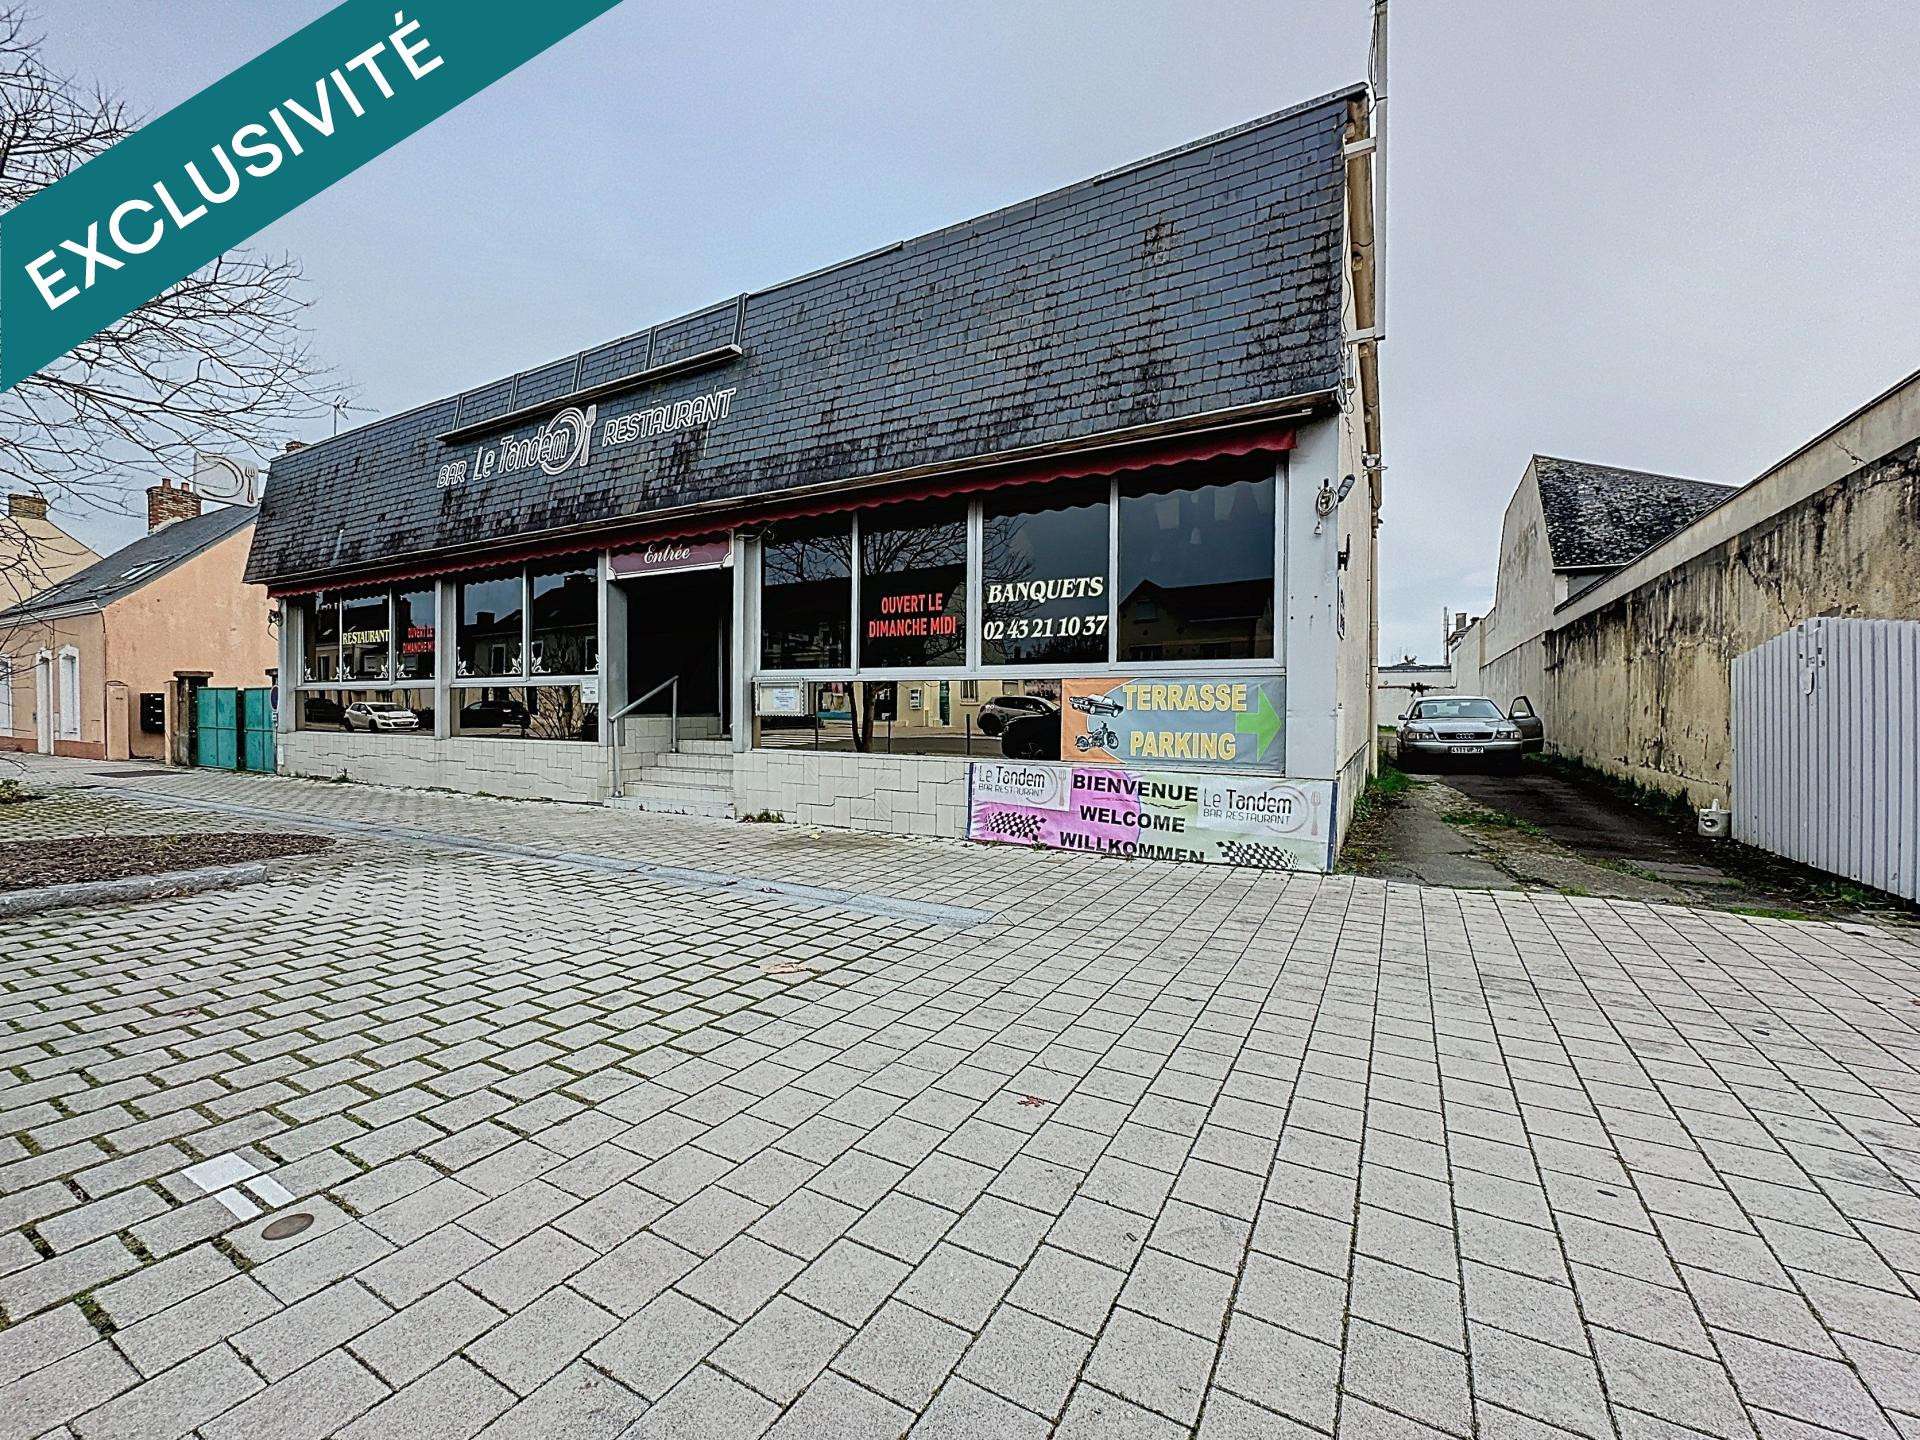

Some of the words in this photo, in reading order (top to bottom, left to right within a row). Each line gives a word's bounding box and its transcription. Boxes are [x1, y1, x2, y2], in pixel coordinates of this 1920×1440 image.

[437, 461, 467, 488] BAR
[473, 446, 494, 481] Le
[498, 426, 570, 473] Tandem
[602, 388, 736, 447] RESTAURANT
[644, 544, 692, 564] Entrée
[987, 576, 1104, 604] BANQUETS
[881, 594, 926, 614] OUVERT
[928, 592, 943, 611] LE
[342, 629, 390, 645] RESTAURANT
[868, 617, 927, 638] DIMANCHE
[930, 616, 957, 635] MIDI
[983, 620, 1004, 640] 02
[1007, 619, 1029, 639] 43
[1031, 618, 1051, 638] 21
[1056, 616, 1081, 637] 10
[1082, 615, 1108, 635] 37
[1122, 684, 1247, 712] TERRASSE
[1129, 730, 1236, 760] PARKING
[979, 765, 993, 782] Le
[996, 766, 1045, 788] Tandem
[1073, 774, 1198, 802] BIENVENUE
[978, 783, 993, 791] BAR
[994, 784, 1045, 797] RESTAURANT
[1203, 788, 1221, 807] Le
[1226, 789, 1292, 814] Tandem
[1079, 805, 1185, 833] WELCOME
[1203, 810, 1222, 818] BAR
[1226, 810, 1290, 825] RESTAURANT
[1059, 831, 1205, 862] WILLKOMMEN
